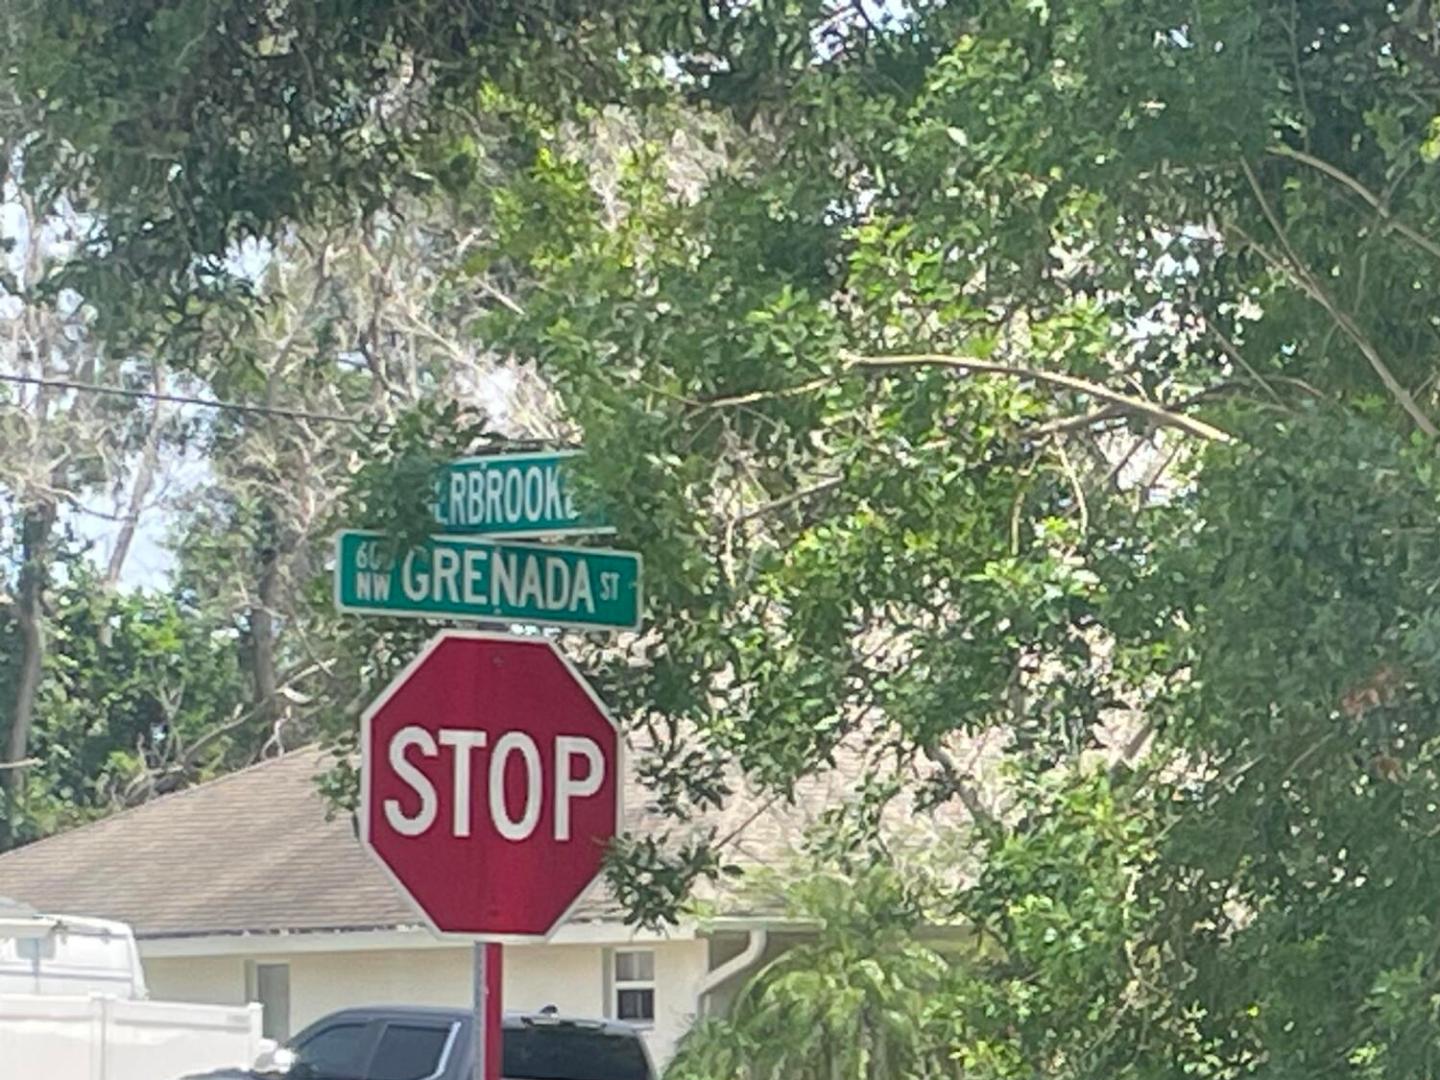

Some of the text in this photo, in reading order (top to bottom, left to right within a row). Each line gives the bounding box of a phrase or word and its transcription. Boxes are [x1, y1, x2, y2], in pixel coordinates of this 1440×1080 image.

[356, 572, 391, 601] NW
[402, 545, 620, 614] GRENADA ST
[384, 725, 606, 841] STOP
